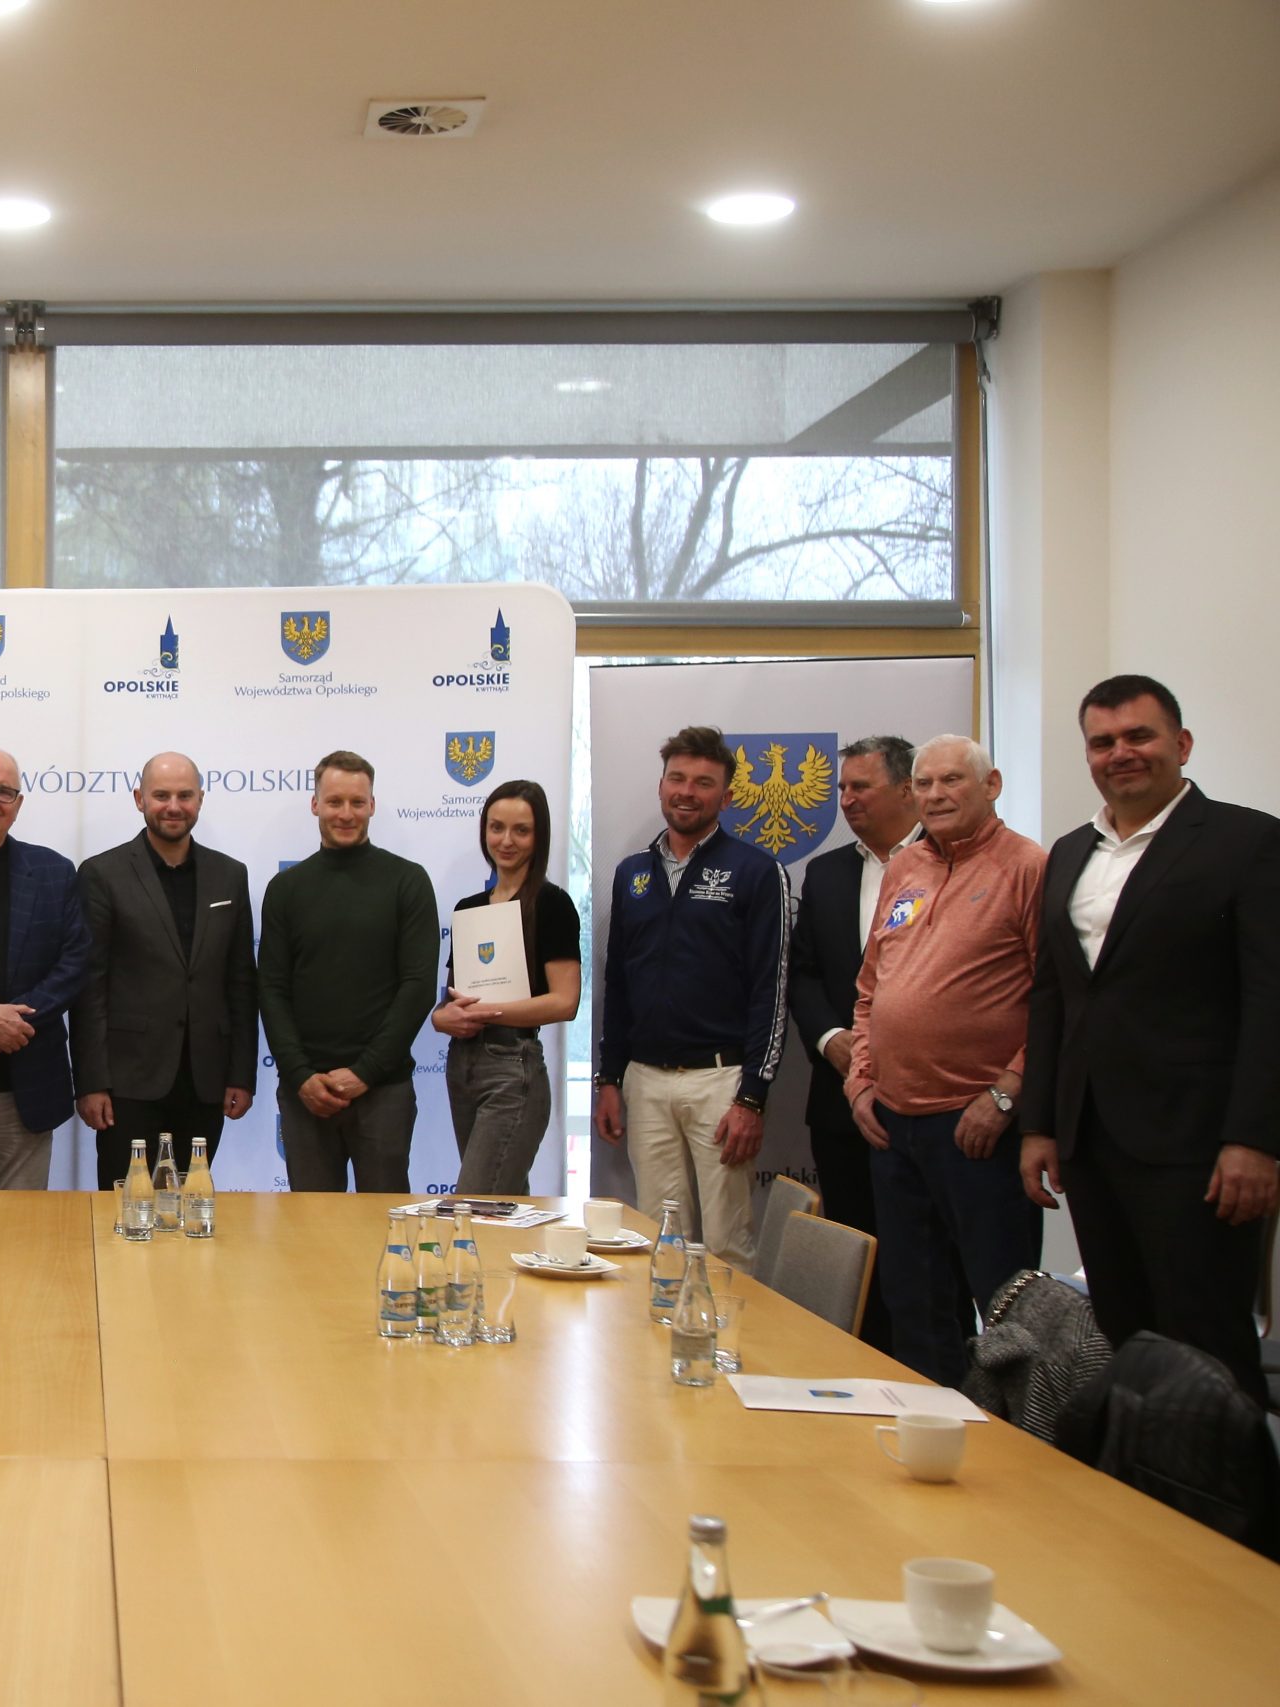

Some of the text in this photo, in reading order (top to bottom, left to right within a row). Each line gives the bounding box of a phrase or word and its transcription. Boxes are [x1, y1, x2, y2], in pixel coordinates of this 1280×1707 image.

[278, 671, 333, 684] Samorząd
[432, 673, 510, 686] OPOLSKIE
[103, 681, 179, 692] OPOLSKIE
[234, 683, 378, 698] Województwa Opolskiego
[397, 807, 475, 821] Województwa
